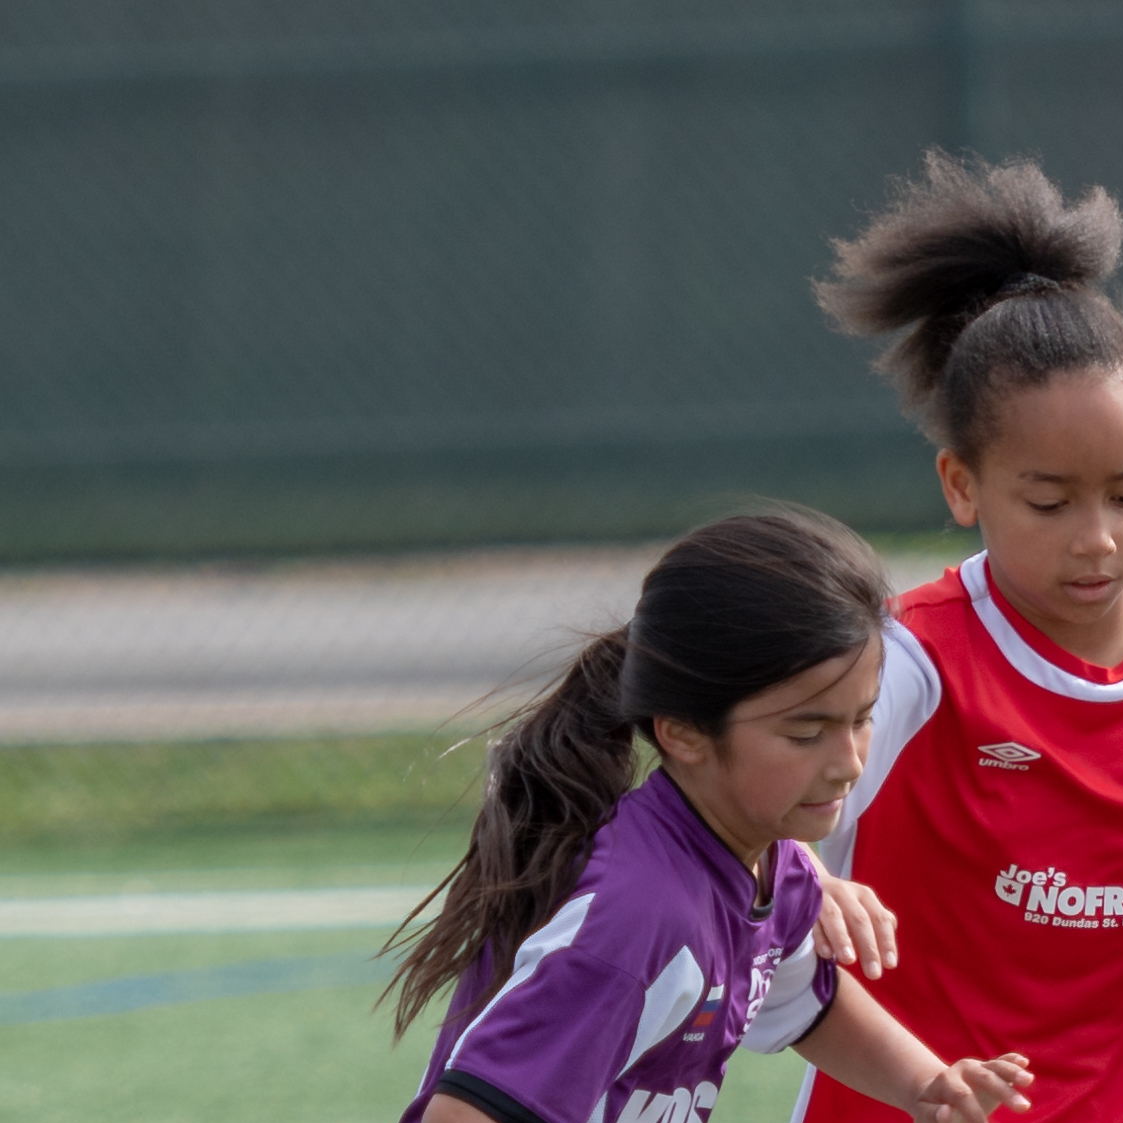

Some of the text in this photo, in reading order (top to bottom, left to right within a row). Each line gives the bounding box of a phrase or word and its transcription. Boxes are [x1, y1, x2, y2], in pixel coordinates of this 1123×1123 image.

[978, 757, 1029, 771] umbro
[1000, 863, 1067, 887] Joe's
[1024, 912, 1049, 925] 920
[1052, 916, 1099, 928] Dundas
[1102, 918, 1119, 928] St.
